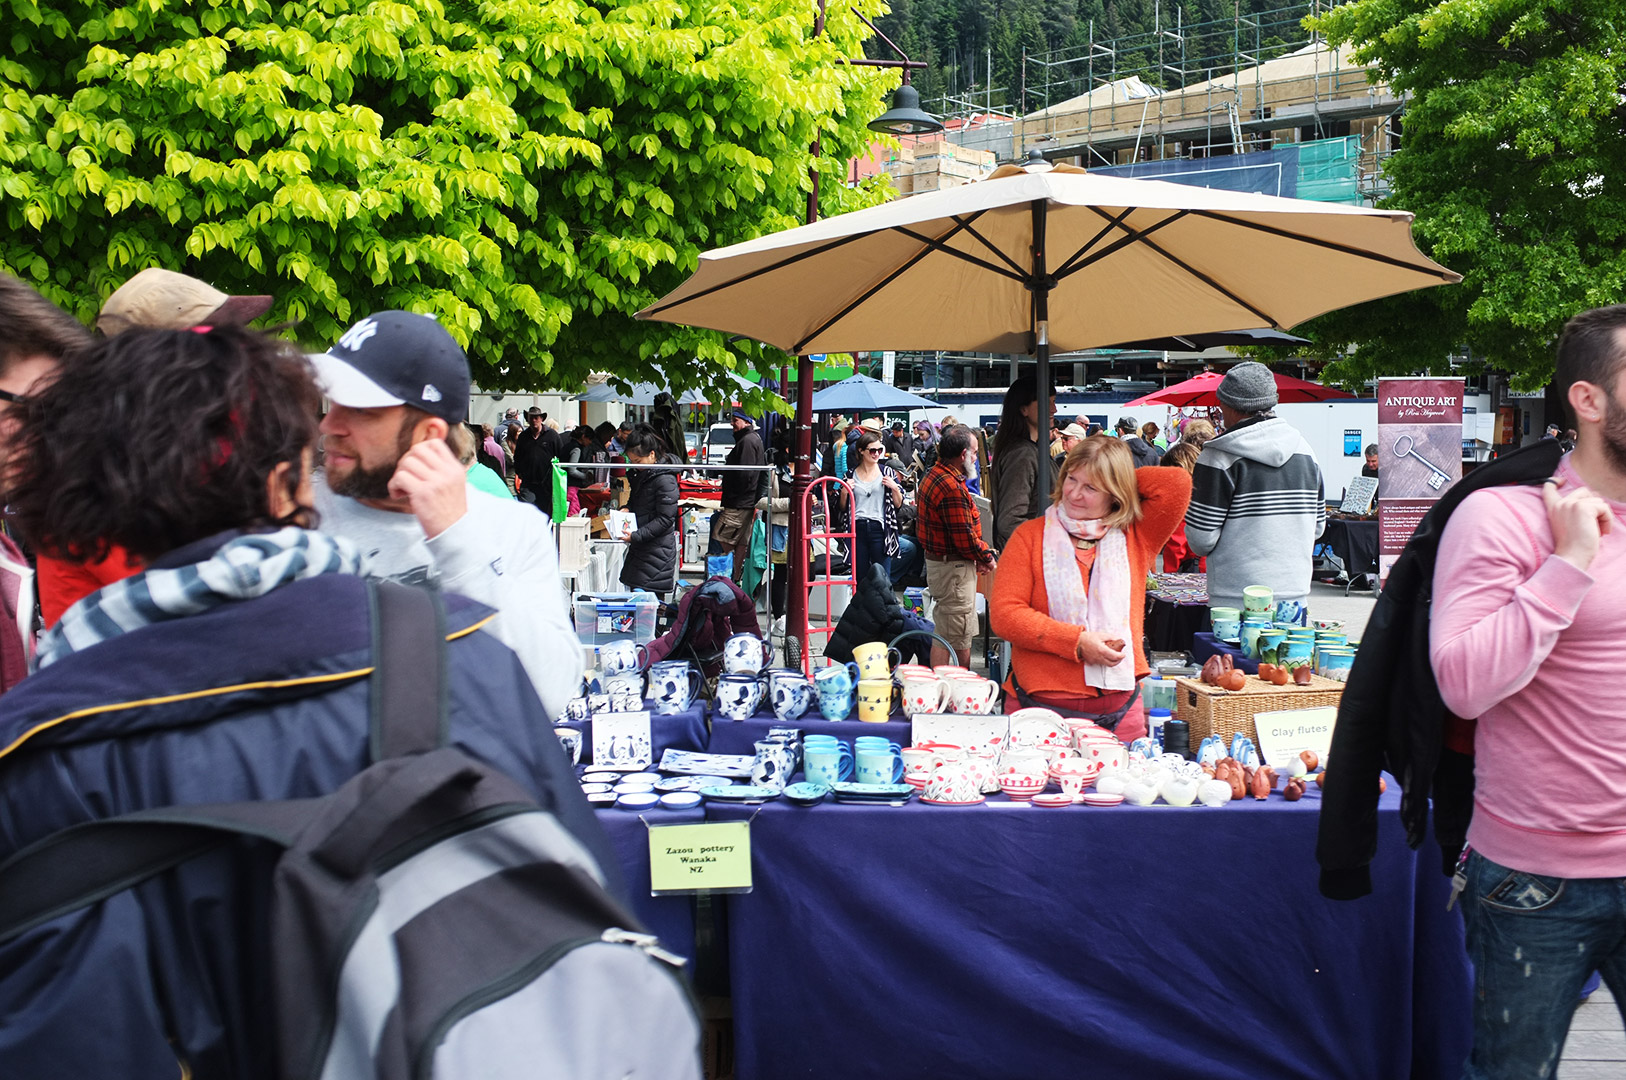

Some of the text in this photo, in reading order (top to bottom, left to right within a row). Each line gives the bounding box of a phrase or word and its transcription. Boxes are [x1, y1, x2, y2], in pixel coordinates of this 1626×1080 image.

[1385, 396, 1457, 408] ANTIQUE ART
[1397, 410, 1405, 418] by
[1271, 725, 1328, 737] Clay flutes
[665, 845, 735, 855] Zazou pottery
[680, 855, 717, 864] Wanaka
[689, 866, 704, 874] NZ
